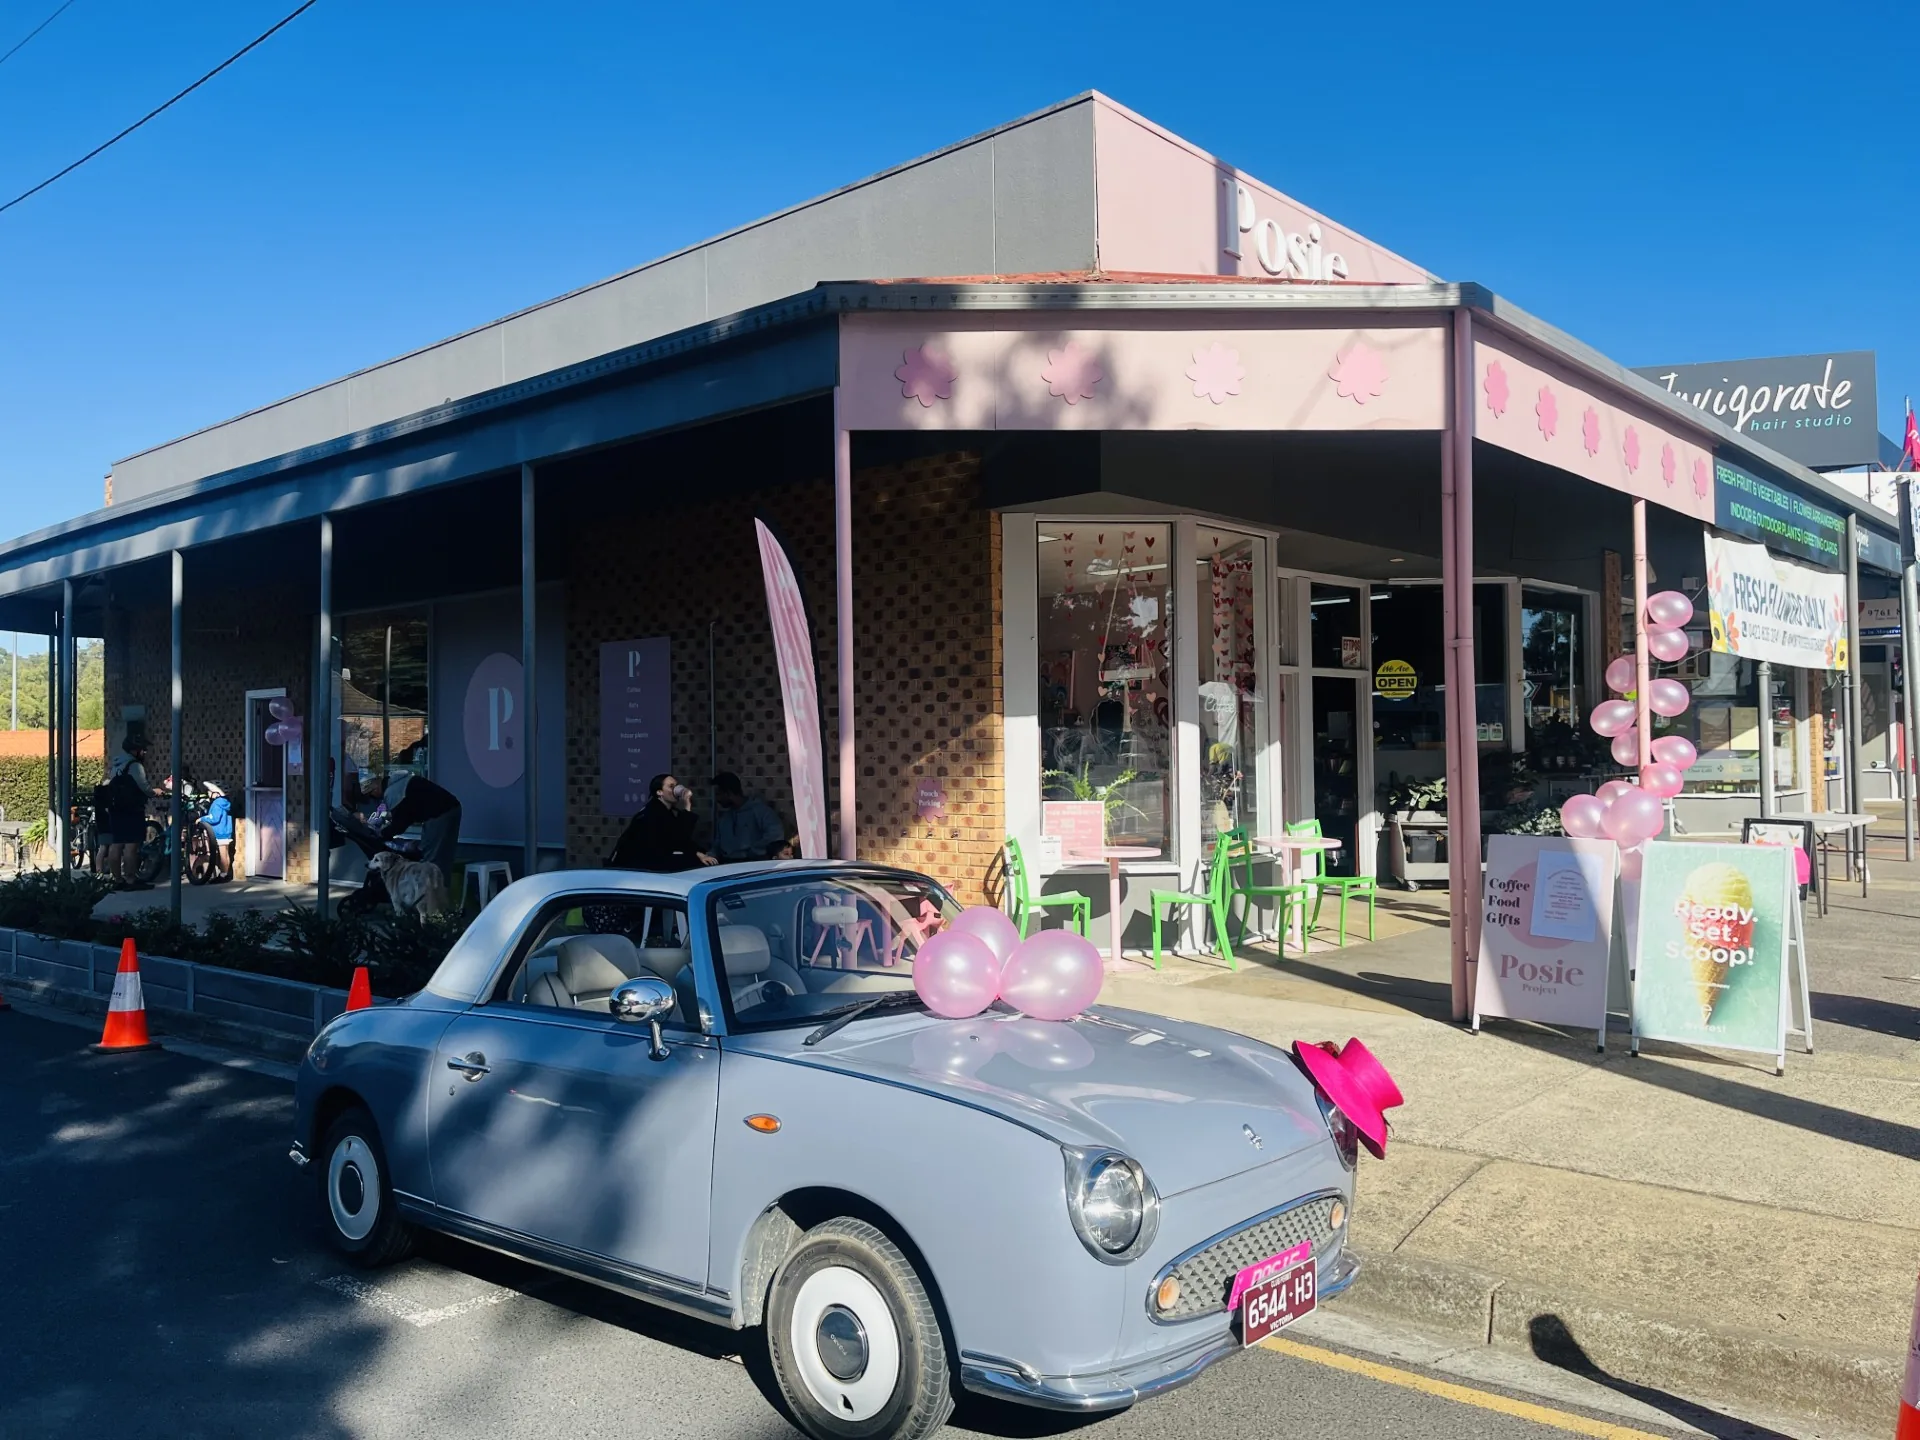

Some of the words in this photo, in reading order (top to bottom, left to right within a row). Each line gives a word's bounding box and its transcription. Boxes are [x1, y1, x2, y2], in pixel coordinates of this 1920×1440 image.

[1223, 178, 1349, 280] Posie
[1751, 418, 1788, 431] hair
[1795, 414, 1852, 428] studio
[1716, 465, 1736, 486] FRESH
[1736, 473, 1752, 493] FRUIT
[1757, 483, 1789, 511] VEGETABLES
[1730, 501, 1752, 523] INDOOR
[1756, 512, 1781, 534] OUTDOOR
[1781, 521, 1801, 542] PLANTS
[1824, 539, 1838, 556] CARDS
[1733, 572, 1768, 616] FRESH
[1803, 595, 1827, 630] DAILY
[1867, 609, 1891, 617] 9761
[1382, 665, 1393, 673] We
[1395, 665, 1411, 673] Are
[1377, 678, 1415, 688] OPEN
[918, 800, 941, 809] Parking
[1489, 877, 1530, 893] Coffee
[1488, 895, 1520, 908] Food
[1486, 911, 1520, 927] Gifts
[1674, 898, 1759, 925] Ready.
[1690, 921, 1739, 942] Set.
[1665, 940, 1755, 967] Scoop!
[1500, 954, 1584, 987] Posie
[1522, 983, 1557, 996] Project
[1270, 1313, 1294, 1331] VICTORIA
